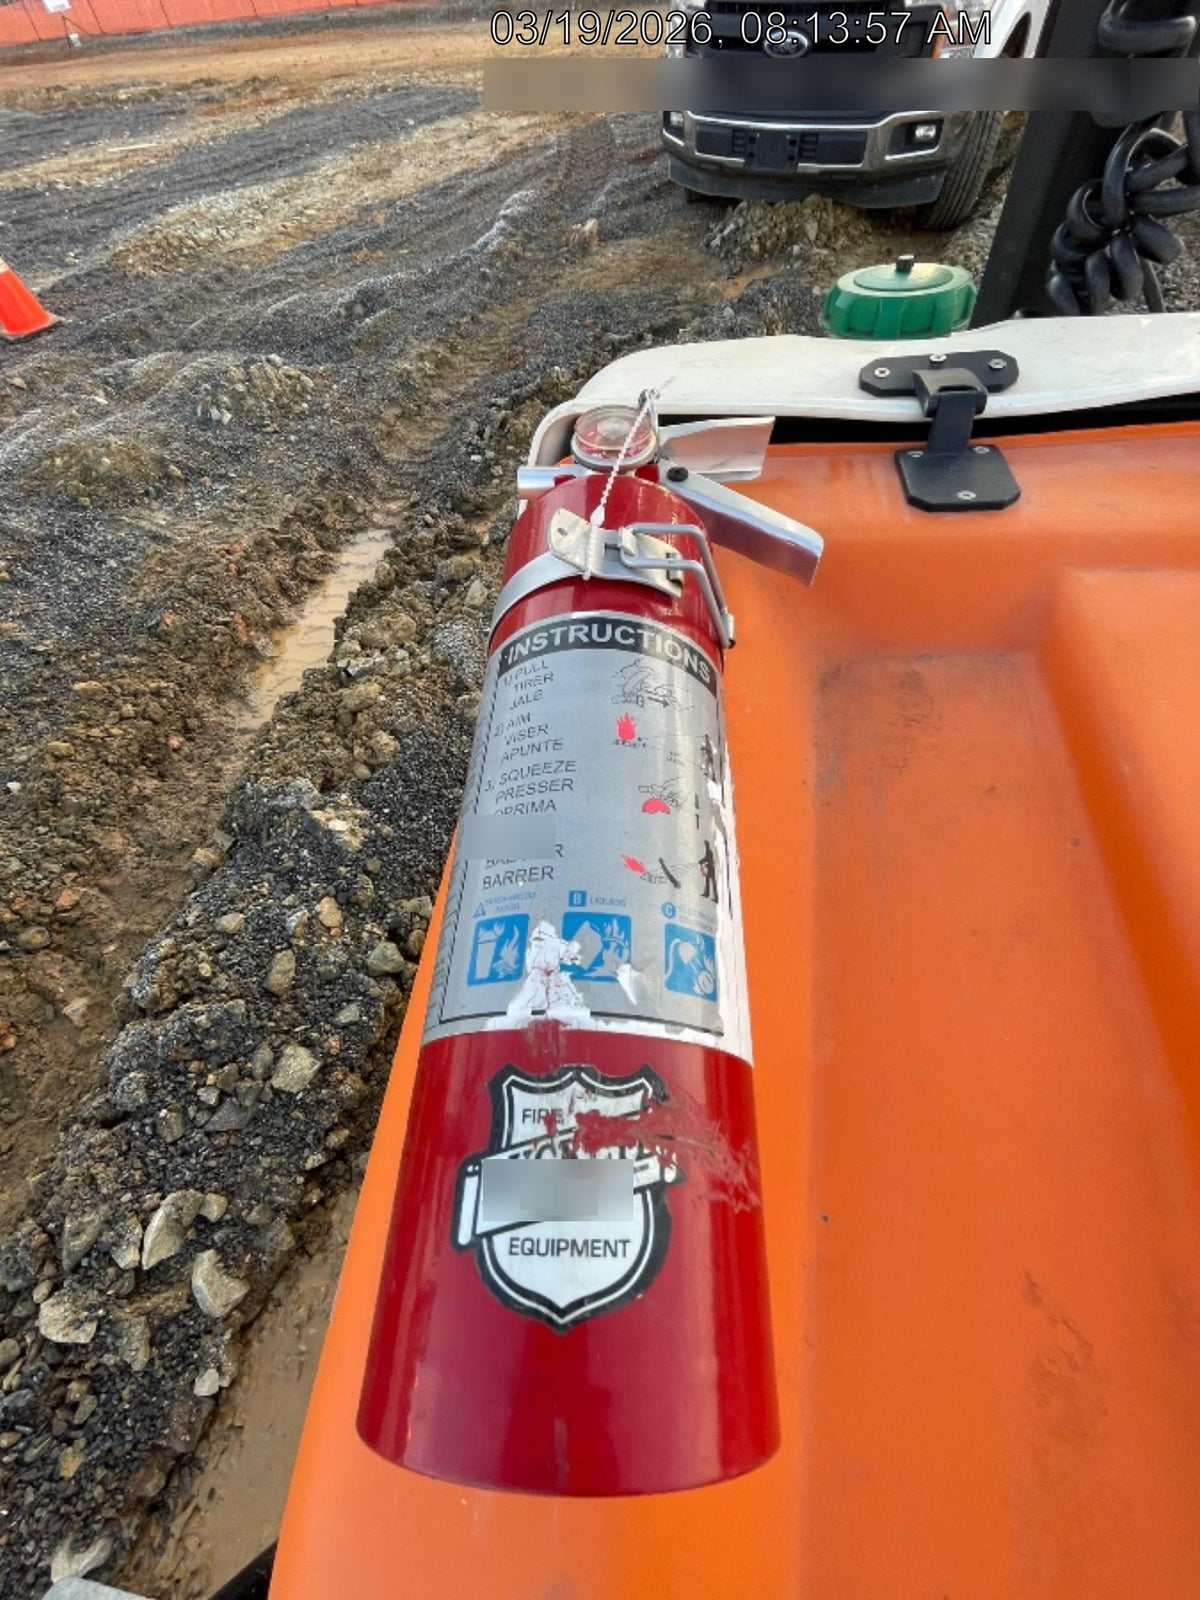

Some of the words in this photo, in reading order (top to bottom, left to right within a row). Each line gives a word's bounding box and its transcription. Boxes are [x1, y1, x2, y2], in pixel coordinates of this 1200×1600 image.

[507, 623, 711, 683] INSTRUCTIONS
[515, 659, 549, 680] PULL
[514, 671, 554, 691] TIRER
[509, 689, 544, 710] JALE
[506, 712, 531, 731] AIM
[505, 724, 549, 746] VISER
[500, 738, 565, 765] APUNTE
[499, 760, 577, 786] SQUEEZE
[495, 778, 574, 804] PRESSER
[482, 865, 554, 890] BARRER
[508, 1237, 631, 1258] EQUIPMENT
